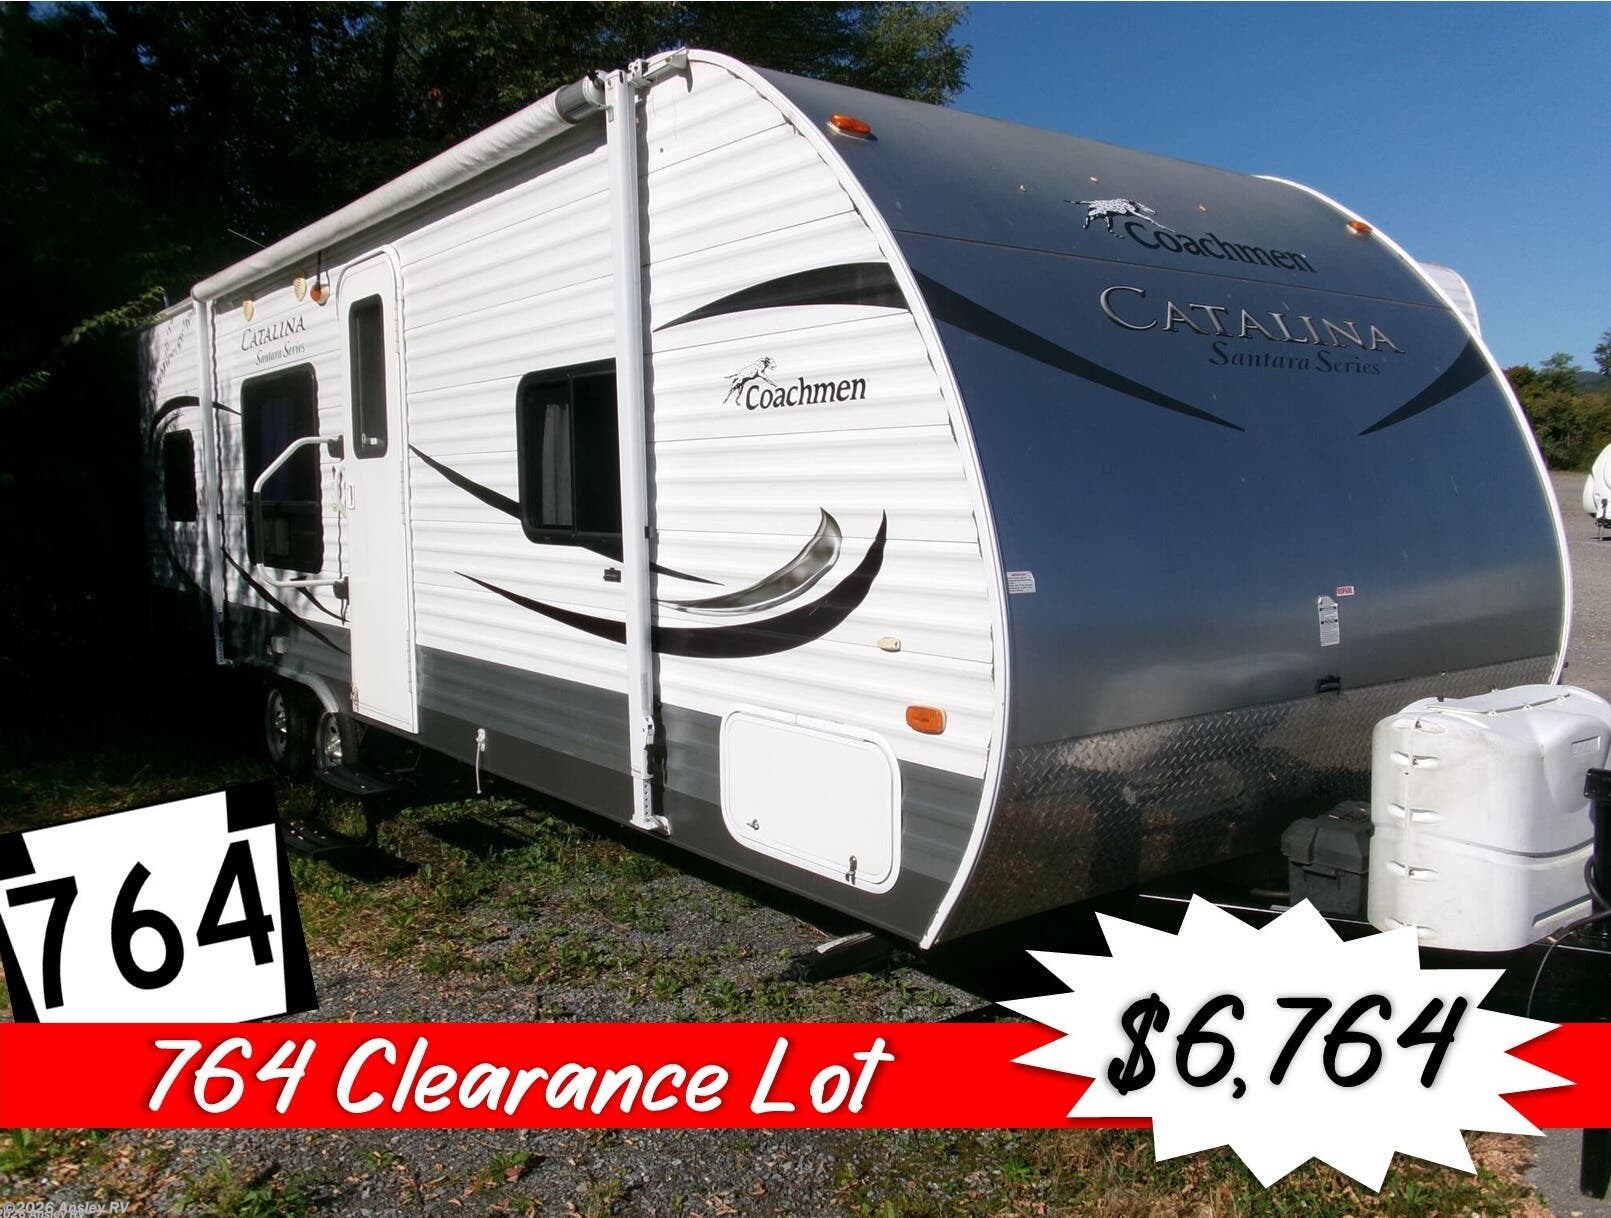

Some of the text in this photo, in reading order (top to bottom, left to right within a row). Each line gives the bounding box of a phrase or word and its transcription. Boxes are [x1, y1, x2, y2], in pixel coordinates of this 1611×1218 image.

[1124, 220, 1316, 273] Coachmen
[241, 314, 306, 351] CATALINA
[1098, 284, 1406, 354] CATALINA
[283, 341, 306, 358] Series
[1209, 341, 1381, 376] Santara Series
[745, 376, 867, 411] Coachmen
